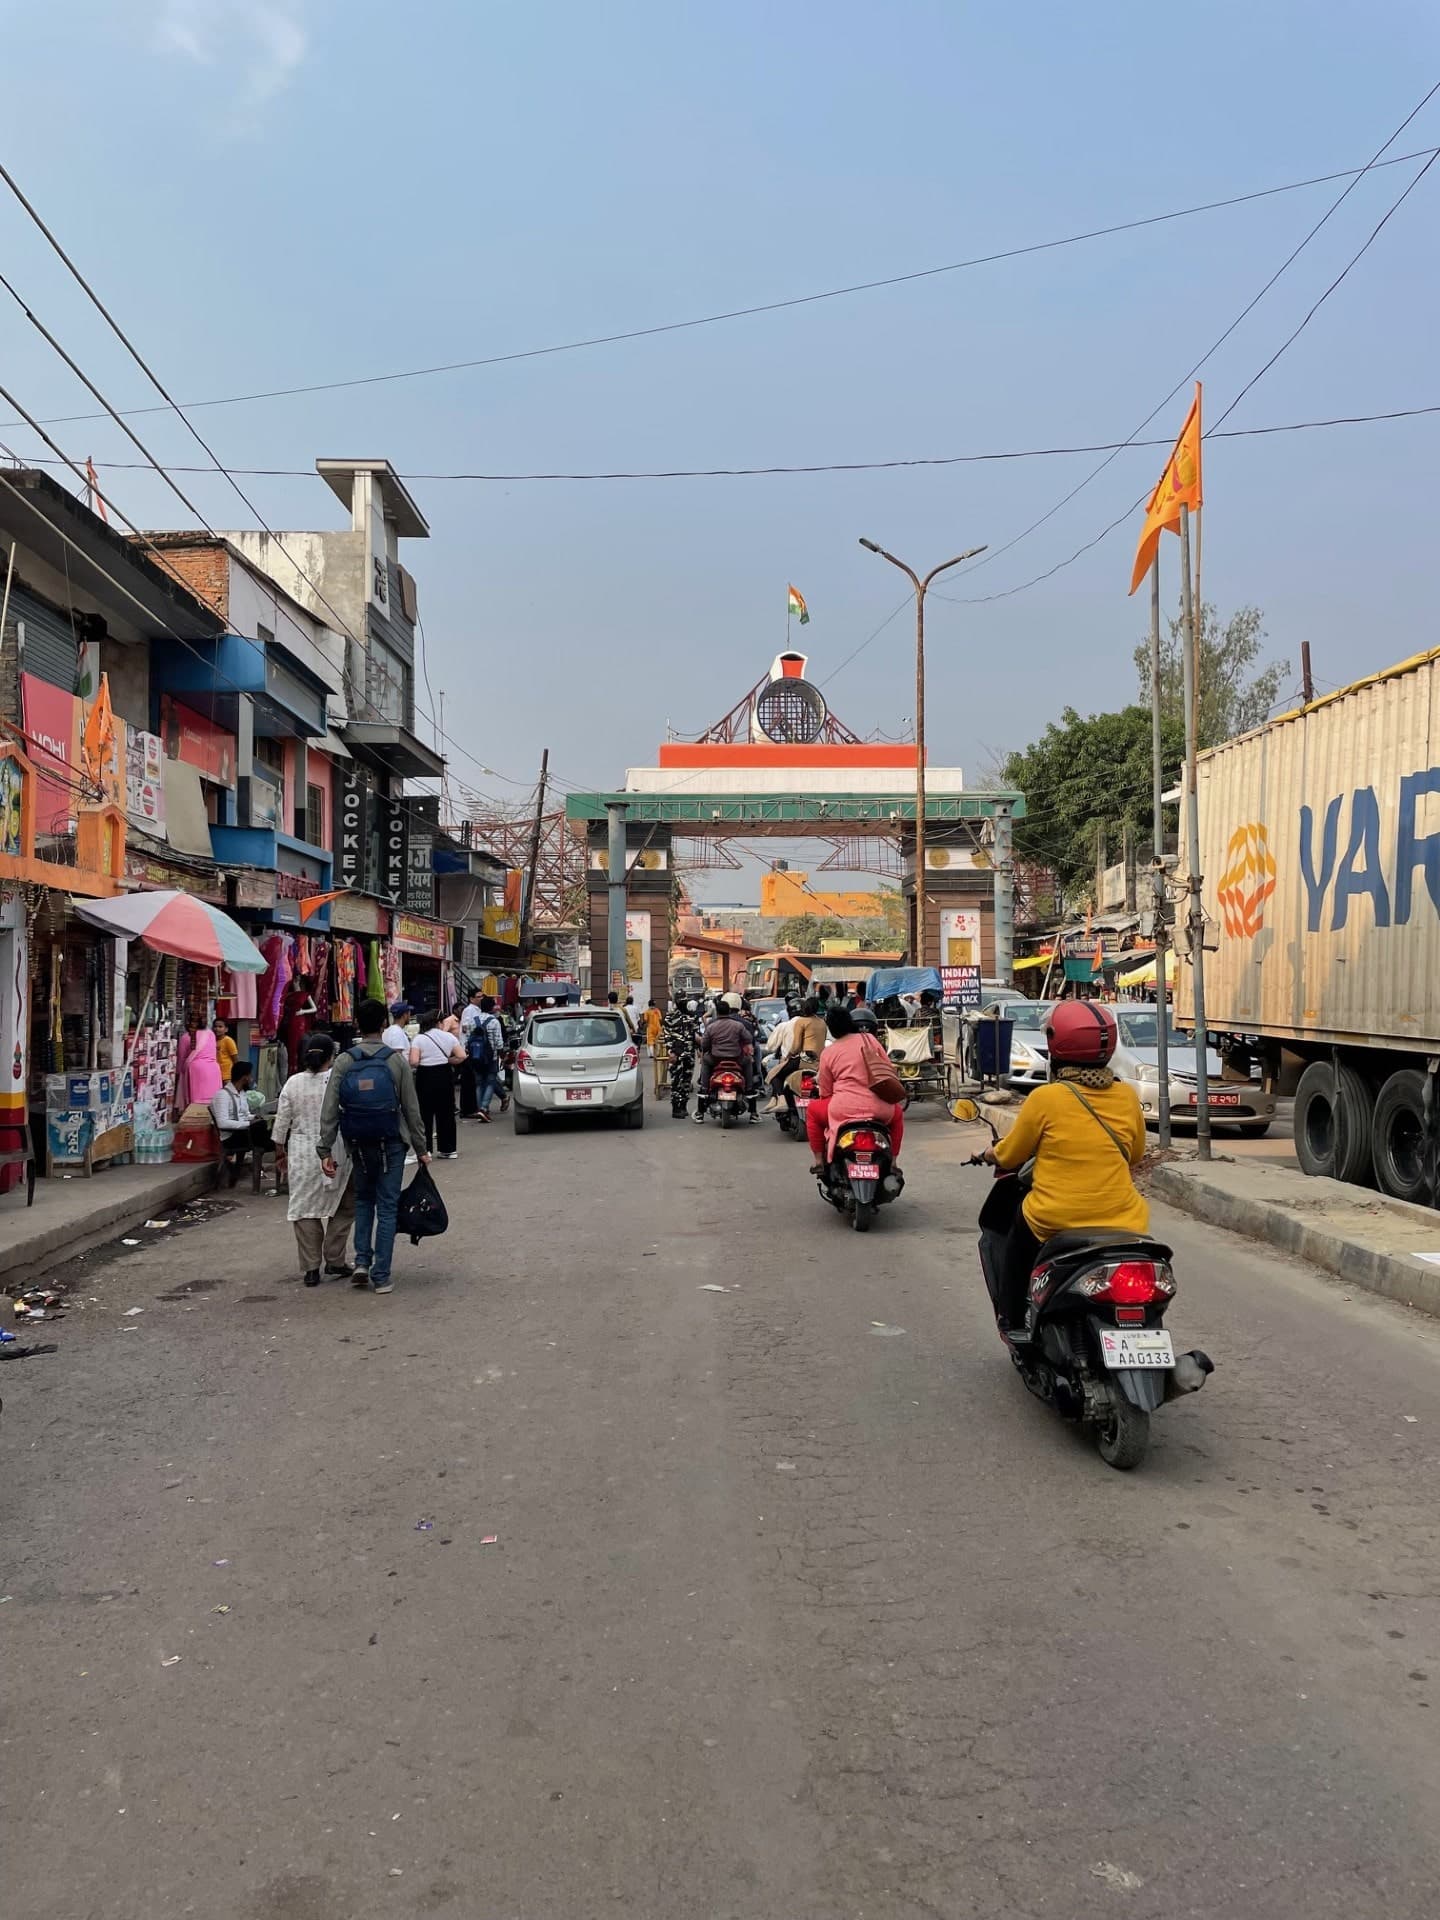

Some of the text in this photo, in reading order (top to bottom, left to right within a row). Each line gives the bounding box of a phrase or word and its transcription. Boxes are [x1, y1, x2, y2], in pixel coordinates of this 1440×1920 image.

[343, 774, 360, 888] JOCKEY
[388, 802, 404, 905] JOCKEY
[942, 968, 977, 978] INDIAN
[943, 978, 979, 988] MMIGRATION
[962, 995, 978, 1004] BACK
[1121, 1339, 1129, 1350] A
[1119, 1352, 1171, 1365] AA0133
